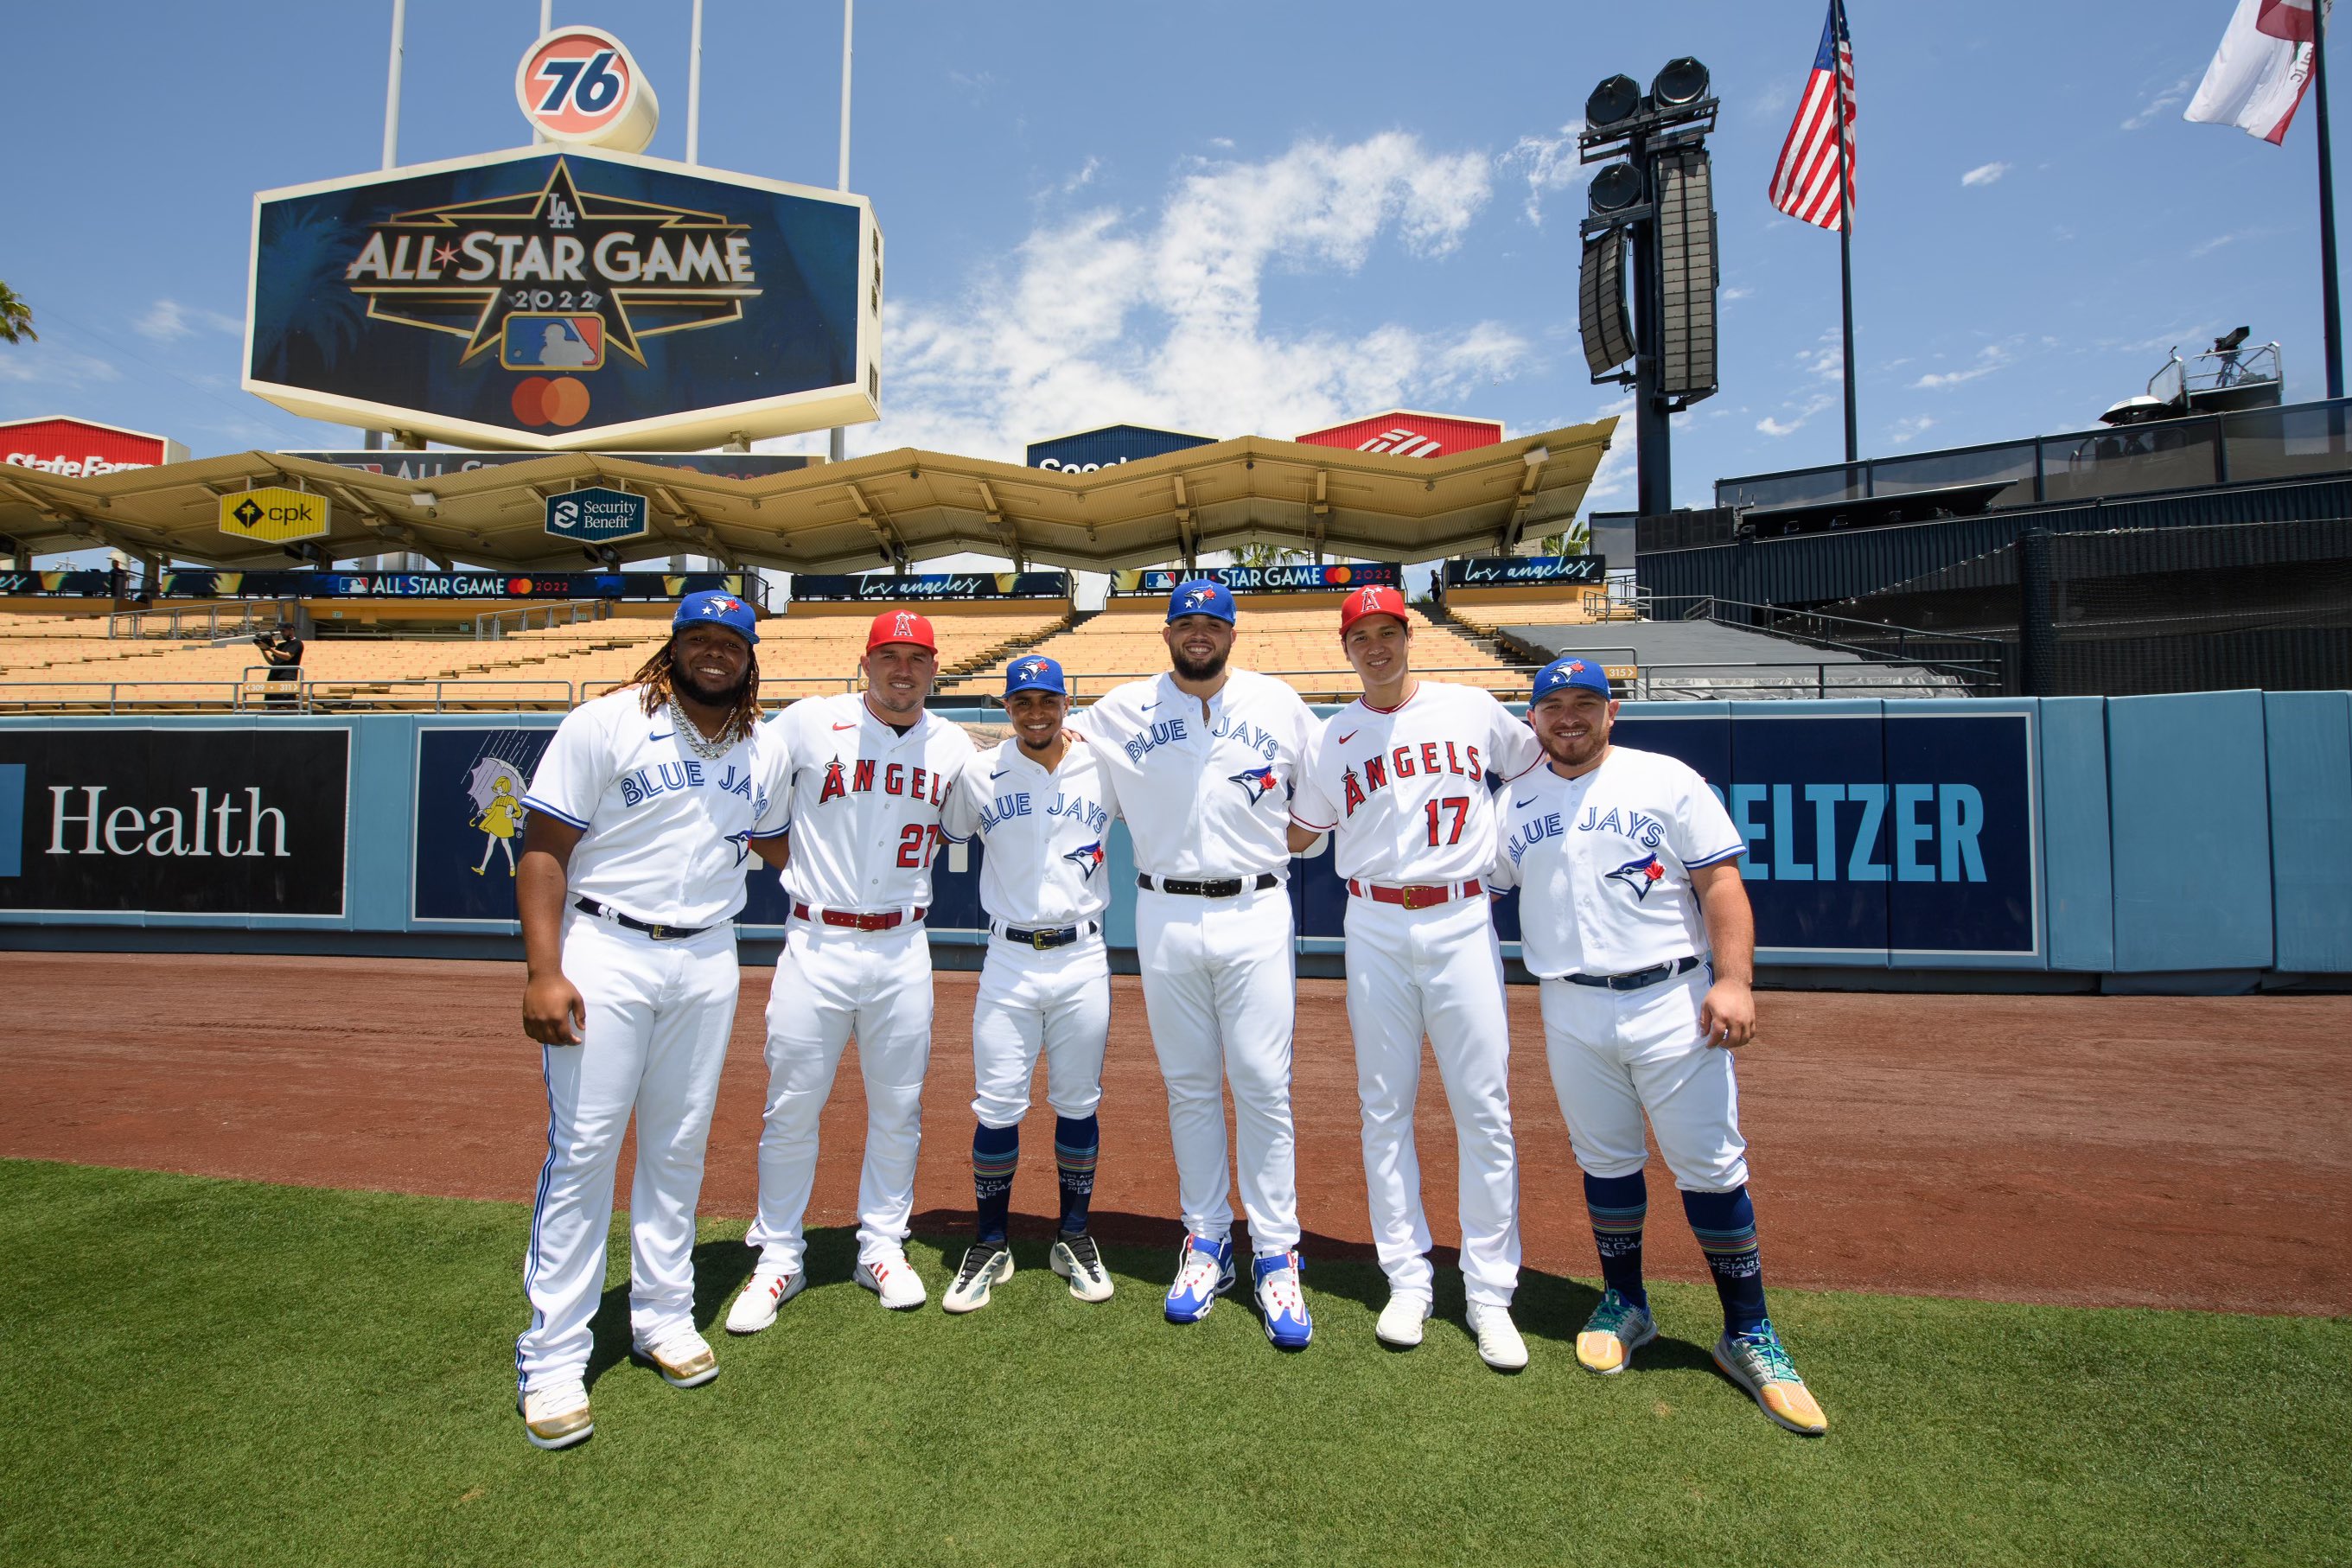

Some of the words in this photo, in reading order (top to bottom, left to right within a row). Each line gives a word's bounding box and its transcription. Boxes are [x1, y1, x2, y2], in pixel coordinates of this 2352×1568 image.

[533, 48, 625, 118] 76
[546, 192, 575, 229] LA
[345, 230, 444, 281] ALL
[456, 230, 587, 282] STAR
[592, 230, 755, 283] GAME
[515, 290, 595, 309] 2022
[268, 503, 313, 529] cpk
[583, 500, 637, 517] Security
[583, 515, 629, 529] Benefit
[373, 576, 404, 595] ALL
[408, 576, 449, 595] STAR
[452, 576, 505, 595] GAME
[535, 582, 569, 592] 2022
[899, 573, 982, 595] angeles
[1217, 568, 1261, 588] STAR
[1265, 566, 1321, 587] GAME
[1354, 569, 1391, 580] 2022
[1507, 555, 1596, 579] angeles
[1361, 587, 1381, 613] A
[893, 612, 914, 637] A
[1609, 668, 1626, 677] 315
[1125, 718, 1189, 764] BLUE
[1211, 716, 1279, 761] JAYS
[621, 760, 705, 808] BLUE
[1341, 741, 1482, 819] ANGELS
[45, 786, 290, 857] Health
[979, 792, 1032, 835] BLUE
[1047, 792, 1107, 835] JAYS
[1425, 796, 1470, 847] 17
[896, 823, 940, 868] 27
[1507, 812, 1564, 870] BLUE
[1578, 806, 1666, 848] JAYS
[1707, 783, 1987, 883] ELTZER
